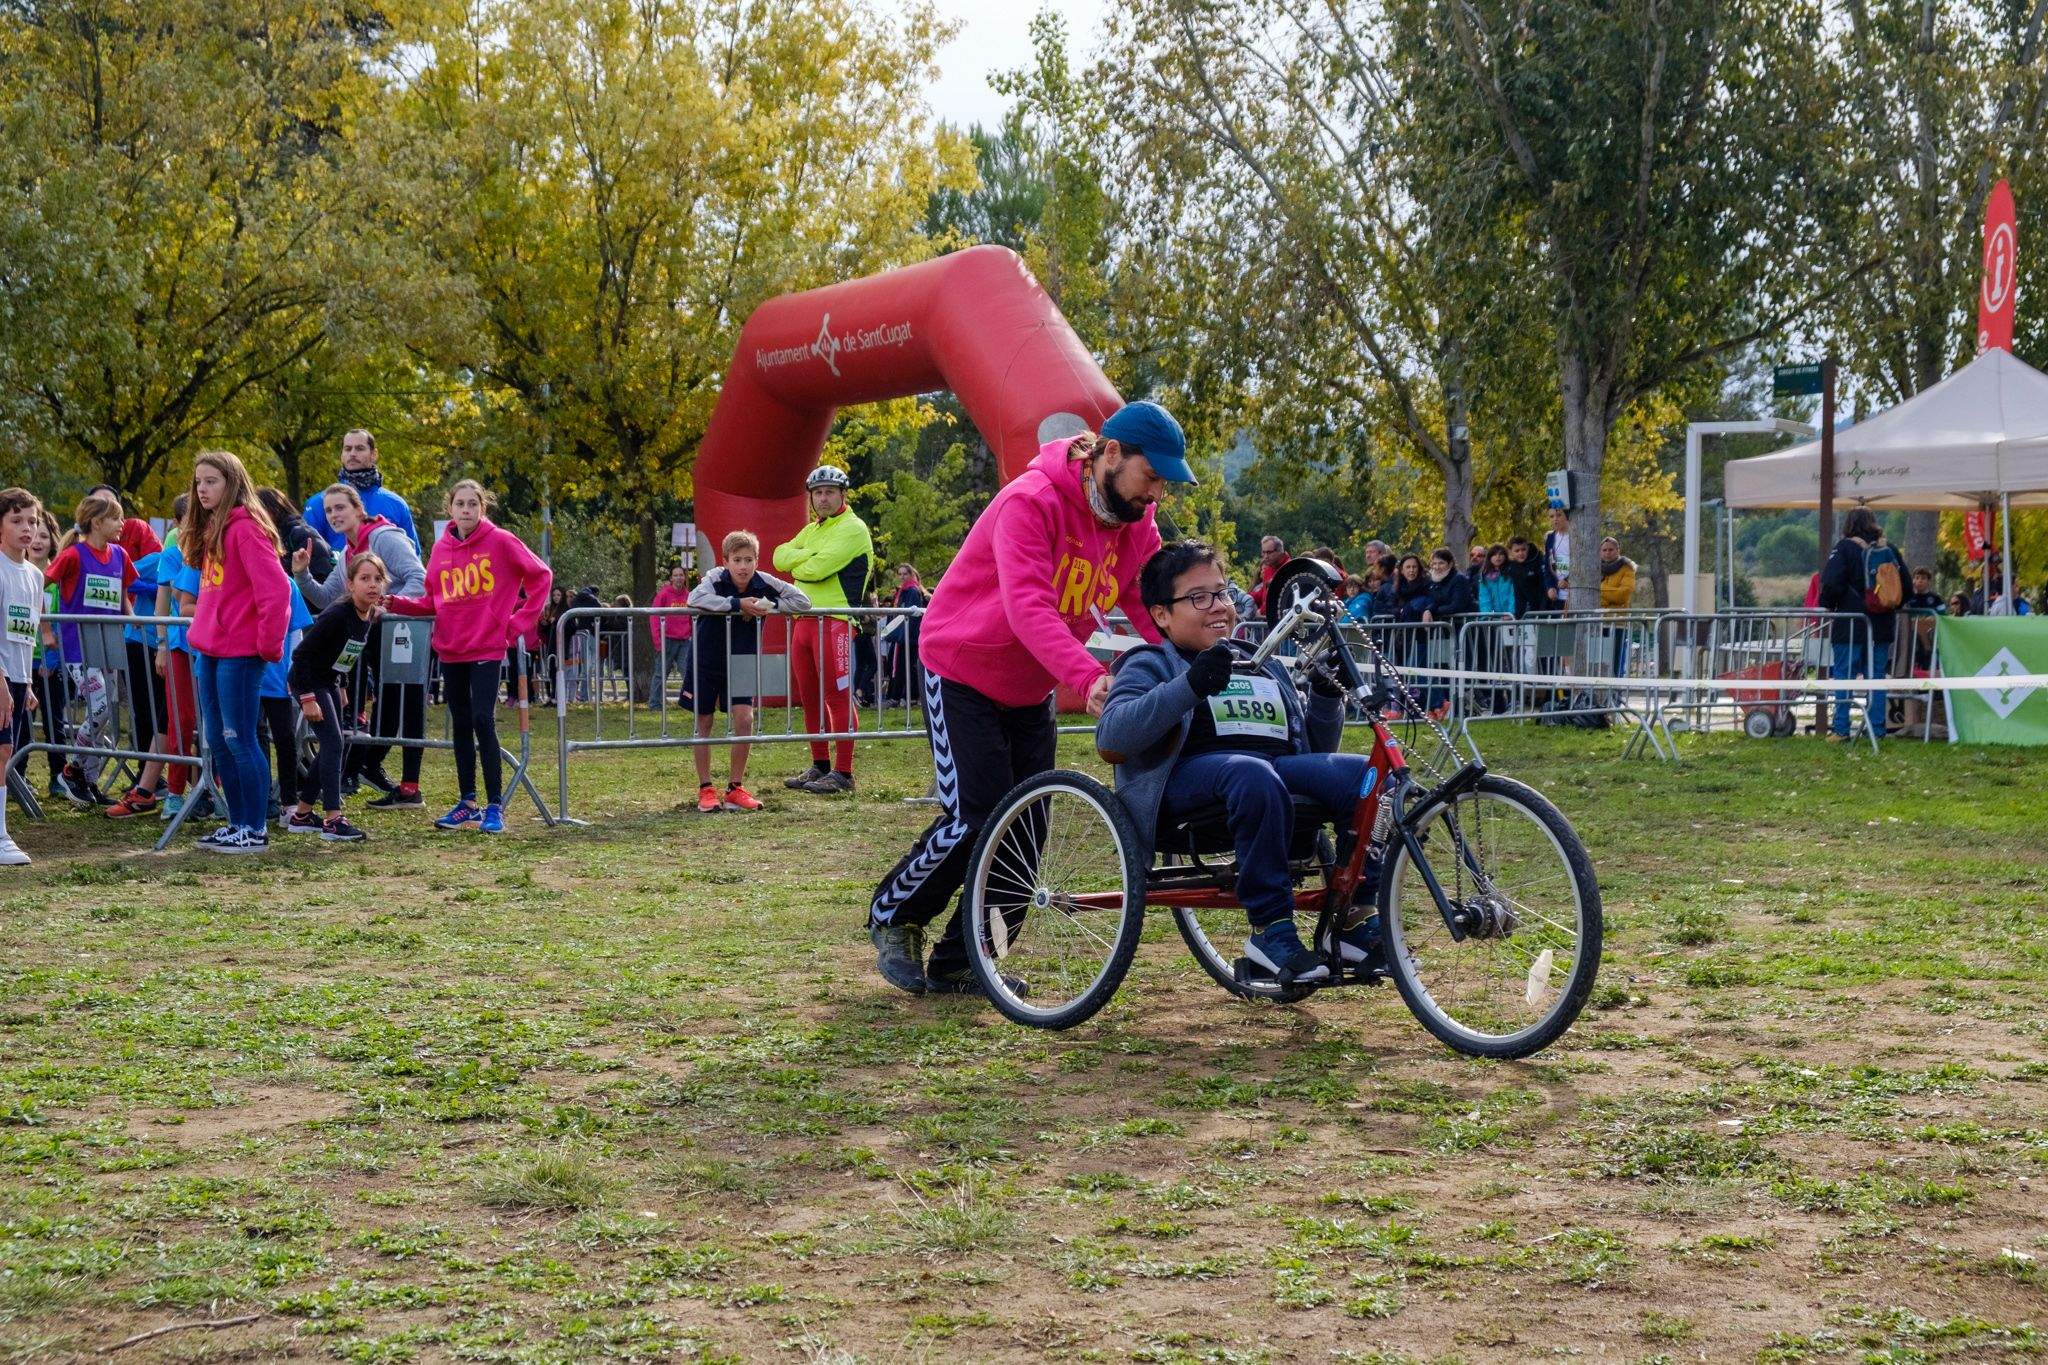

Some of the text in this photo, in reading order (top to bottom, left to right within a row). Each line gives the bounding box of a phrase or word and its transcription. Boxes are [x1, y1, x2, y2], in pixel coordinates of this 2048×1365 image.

[756, 320, 913, 372] Ajuntament de SantCugat
[440, 559, 494, 600] CROS
[92, 588, 118, 601] 2917
[12, 618, 35, 635] 1224
[1227, 681, 1251, 689] CROS
[1222, 699, 1277, 721] 1589
